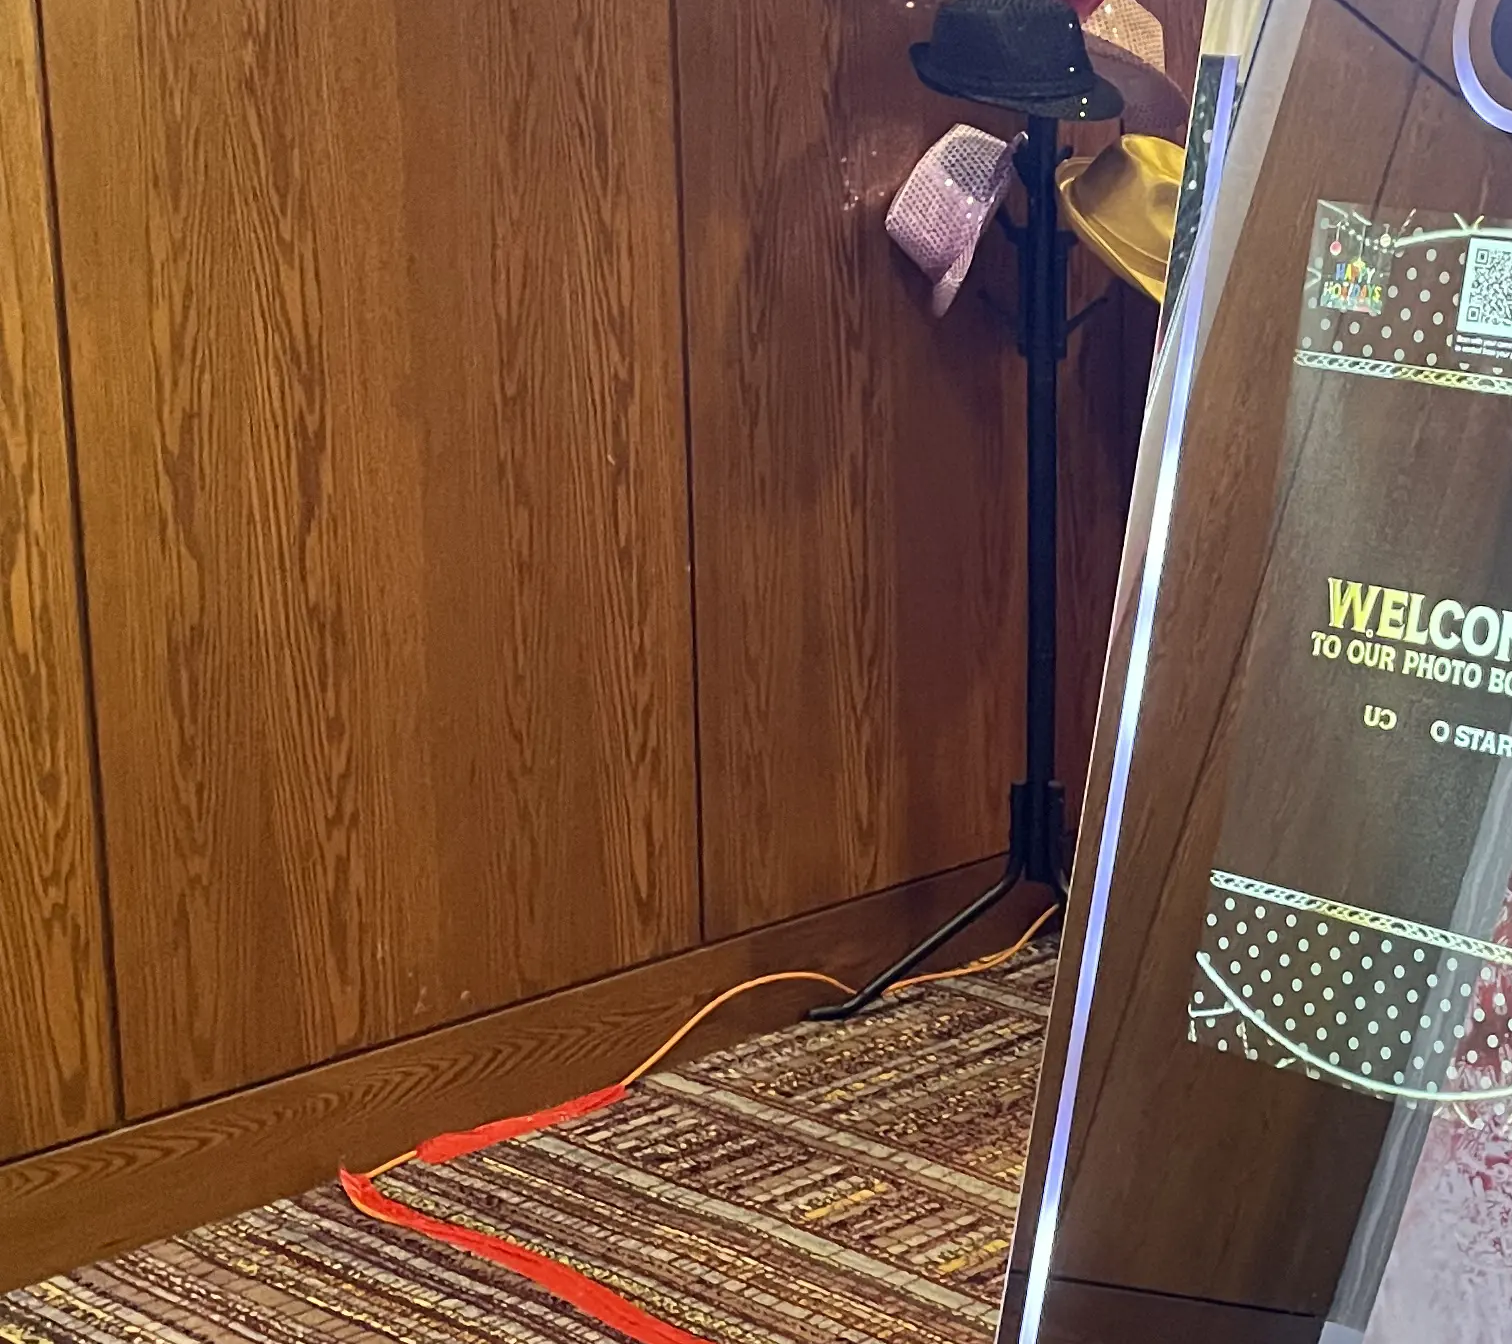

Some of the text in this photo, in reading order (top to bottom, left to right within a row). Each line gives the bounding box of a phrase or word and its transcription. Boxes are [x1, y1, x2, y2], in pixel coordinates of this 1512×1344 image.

[1311, 630, 1342, 659] TO
[1346, 639, 1396, 673] OUR
[1401, 649, 1482, 689] PHOTO
